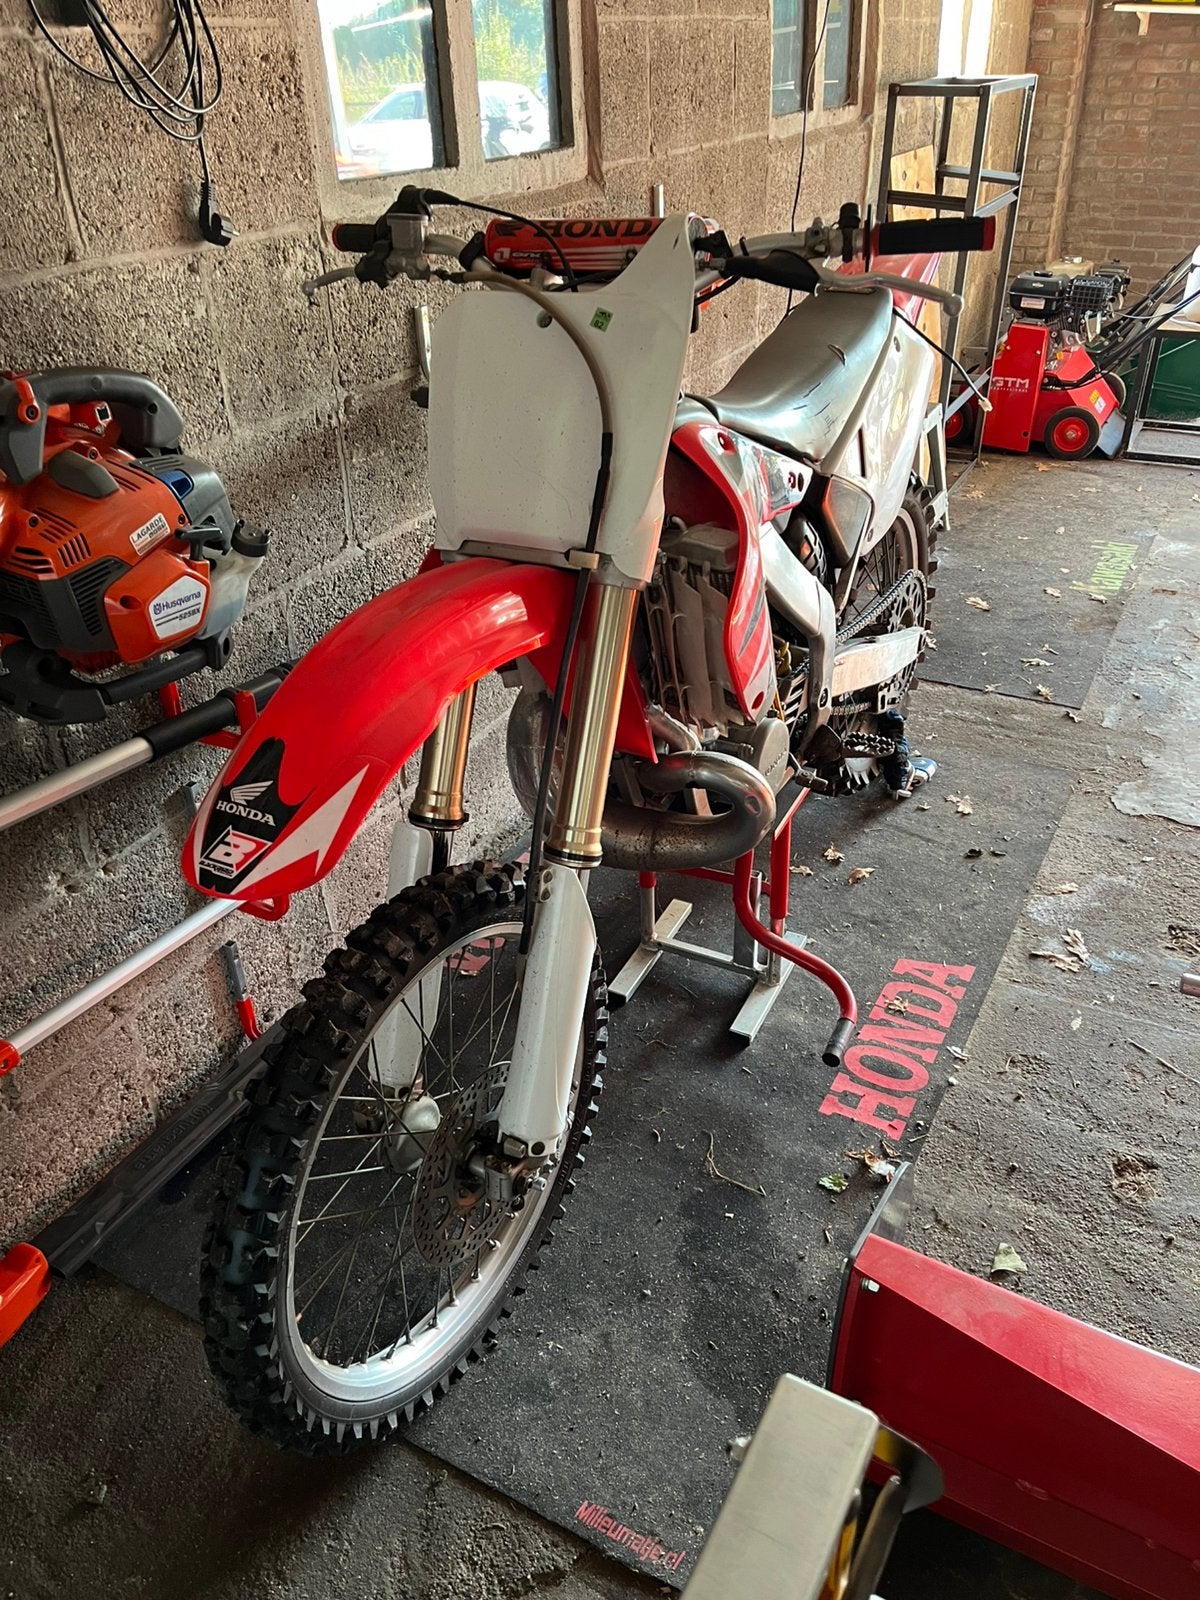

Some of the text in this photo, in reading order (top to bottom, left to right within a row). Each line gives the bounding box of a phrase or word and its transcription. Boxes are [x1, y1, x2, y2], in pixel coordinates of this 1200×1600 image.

[992, 376, 1029, 389] GTM
[131, 514, 163, 543] LAGARDE
[162, 591, 201, 611] Husqvarna
[216, 801, 276, 826] HONDA
[818, 958, 976, 1141] HONDA
